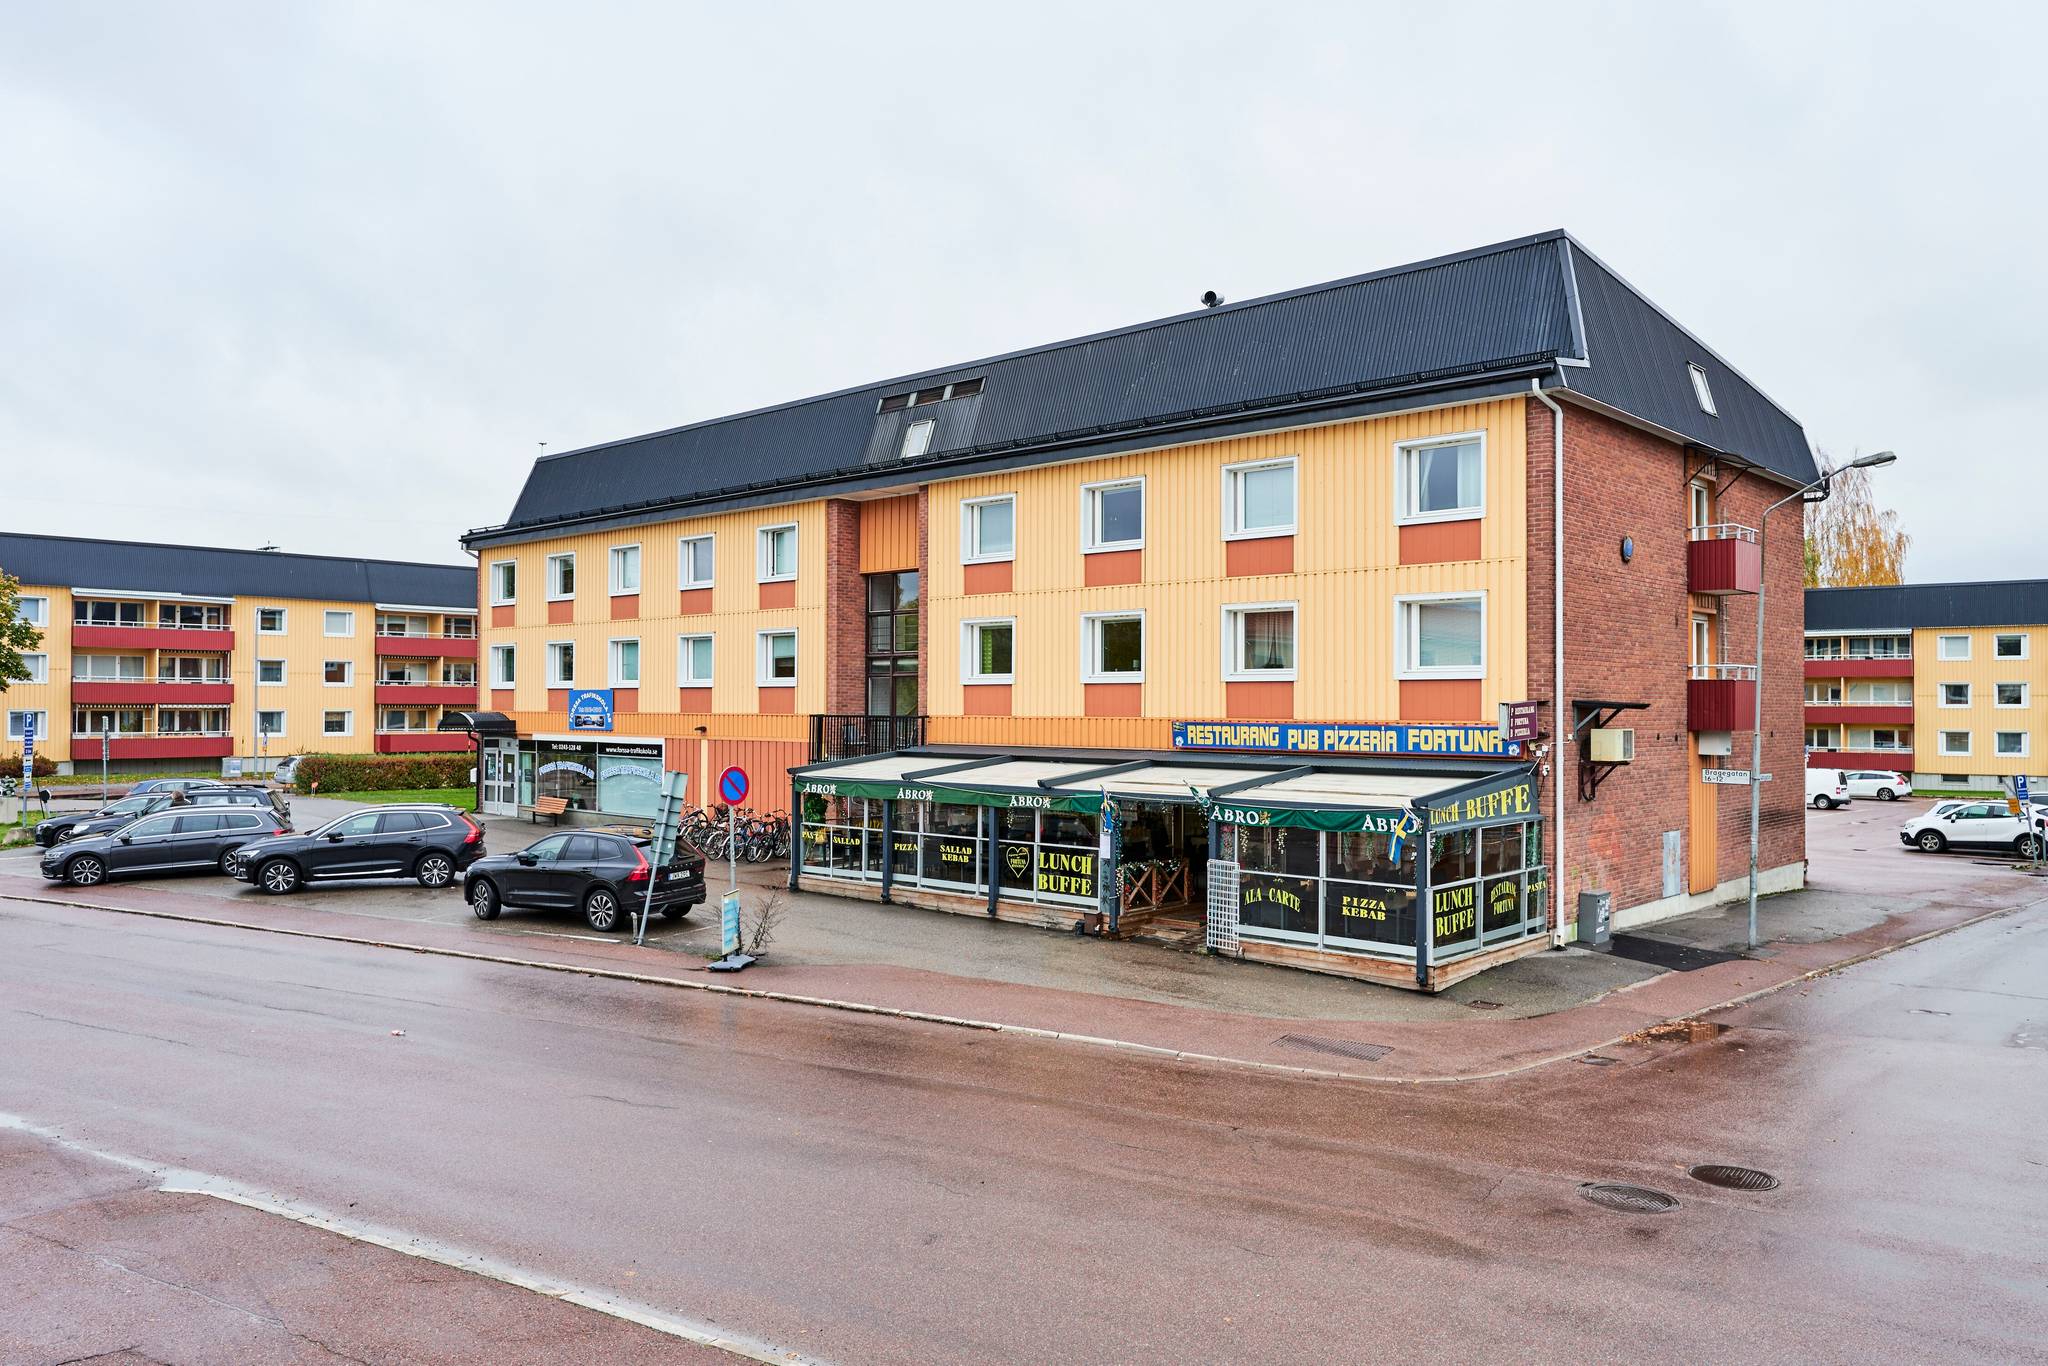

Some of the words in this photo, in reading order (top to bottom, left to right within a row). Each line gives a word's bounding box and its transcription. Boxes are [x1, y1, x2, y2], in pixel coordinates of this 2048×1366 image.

[26, 714, 32, 727] P
[1187, 725, 1279, 747] RESTAURANG
[1287, 729, 1319, 750] PUB
[1407, 729, 1503, 753] FORTUNA
[2017, 776, 2024, 788] P
[1430, 804, 1460, 826] LUNCH
[1466, 783, 1531, 821] BUFFE
[1210, 805, 1260, 826] ÅBRO
[802, 831, 825, 842] PASTA
[832, 836, 860, 846] SALLAD
[894, 843, 919, 851] PIZZA
[939, 844, 973, 855] SALLAD
[941, 853, 969, 863] KEBAB
[1039, 852, 1092, 876] LUNCH
[1038, 873, 1092, 896] BUFFE
[1527, 880, 1547, 894] PASTA
[1244, 888, 1262, 906] ALA
[1269, 887, 1300, 913] CARTE
[1342, 895, 1387, 911] PIZZA
[1435, 886, 1473, 914] LUNCH
[1493, 897, 1514, 916] FORTUNA
[1342, 906, 1386, 921] KEBAB
[1435, 908, 1475, 938] BUFFE
